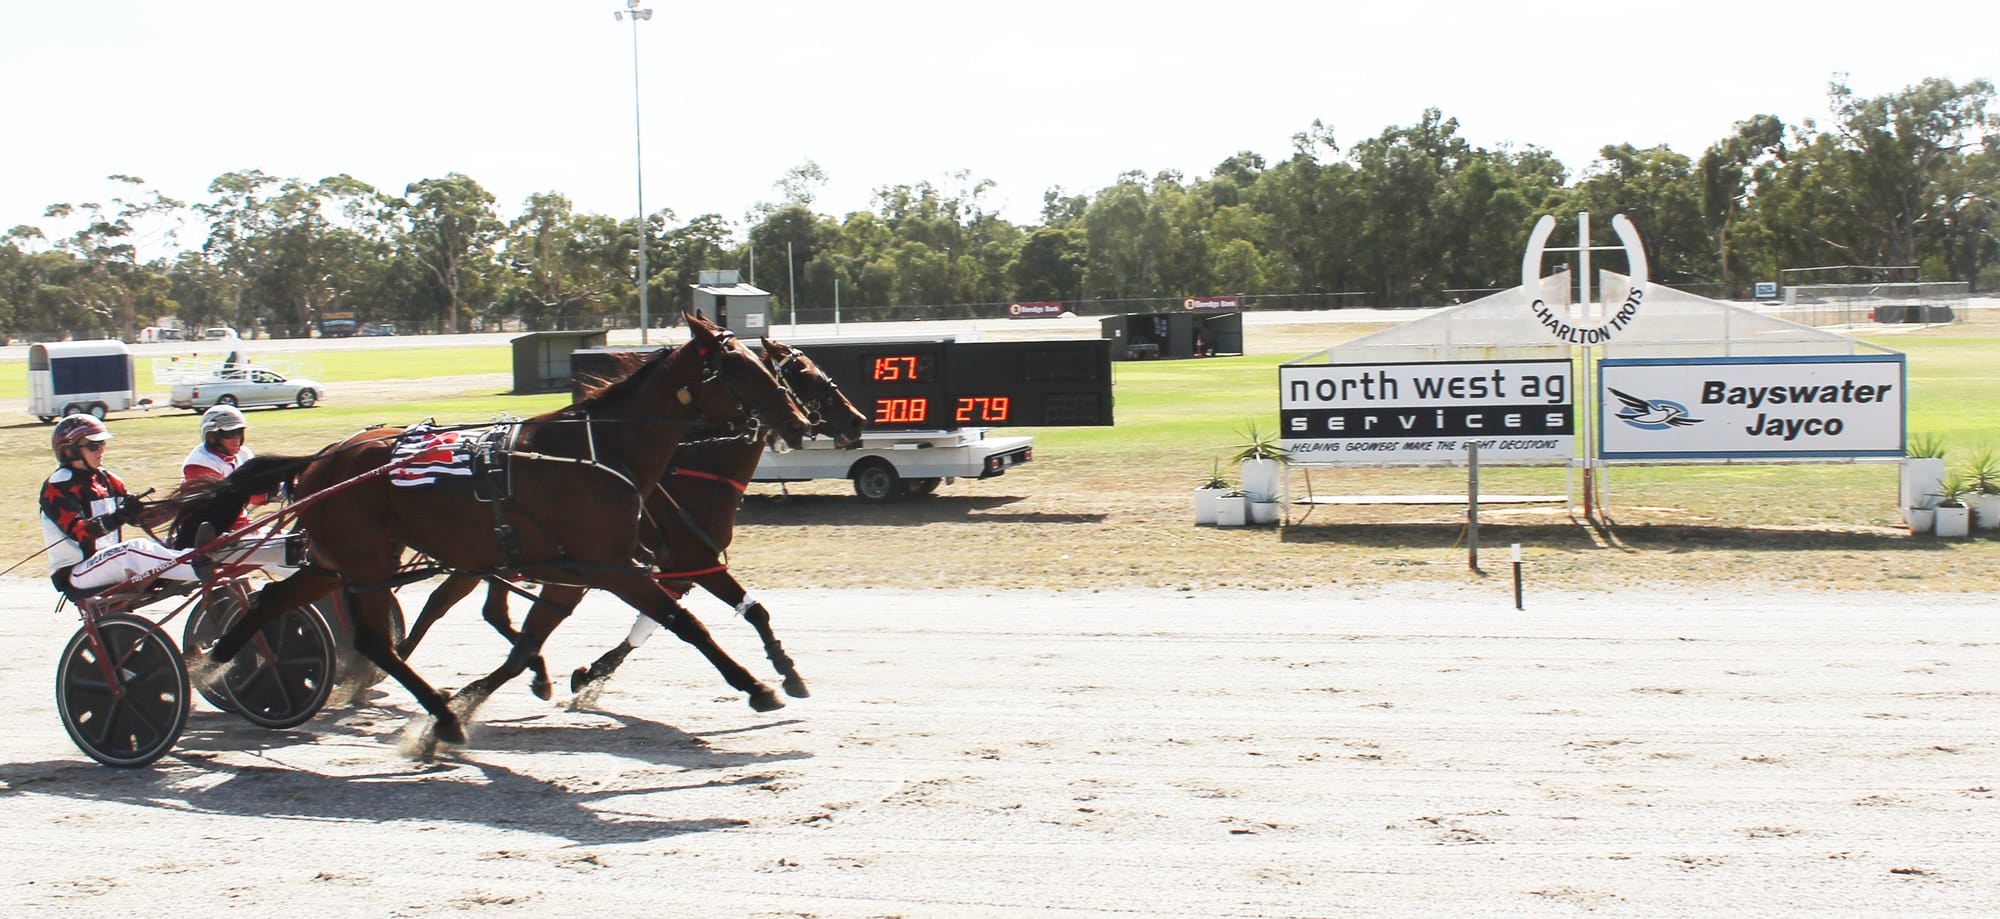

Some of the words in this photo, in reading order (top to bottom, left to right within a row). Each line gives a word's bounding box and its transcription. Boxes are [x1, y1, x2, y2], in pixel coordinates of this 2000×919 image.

[1531, 299, 1611, 344] CHARLTON
[1609, 286, 1643, 331] TROTS
[1290, 371, 1399, 402] north
[1412, 369, 1507, 399] west
[1520, 374, 1565, 404] ag
[1700, 380, 1893, 409] Bayswater
[874, 398, 928, 423] 30.8
[955, 397, 1009, 421] 27.9
[1290, 409, 1565, 432] services
[1745, 412, 1845, 441] Jayco
[1292, 442, 1340, 453] HELPING
[1345, 441, 1400, 452] GROWERS
[1402, 441, 1433, 451] MAKE
[1436, 441, 1457, 451] THE
[1461, 440, 1497, 451] RGHT
[1499, 439, 1559, 450] DECISIONS
